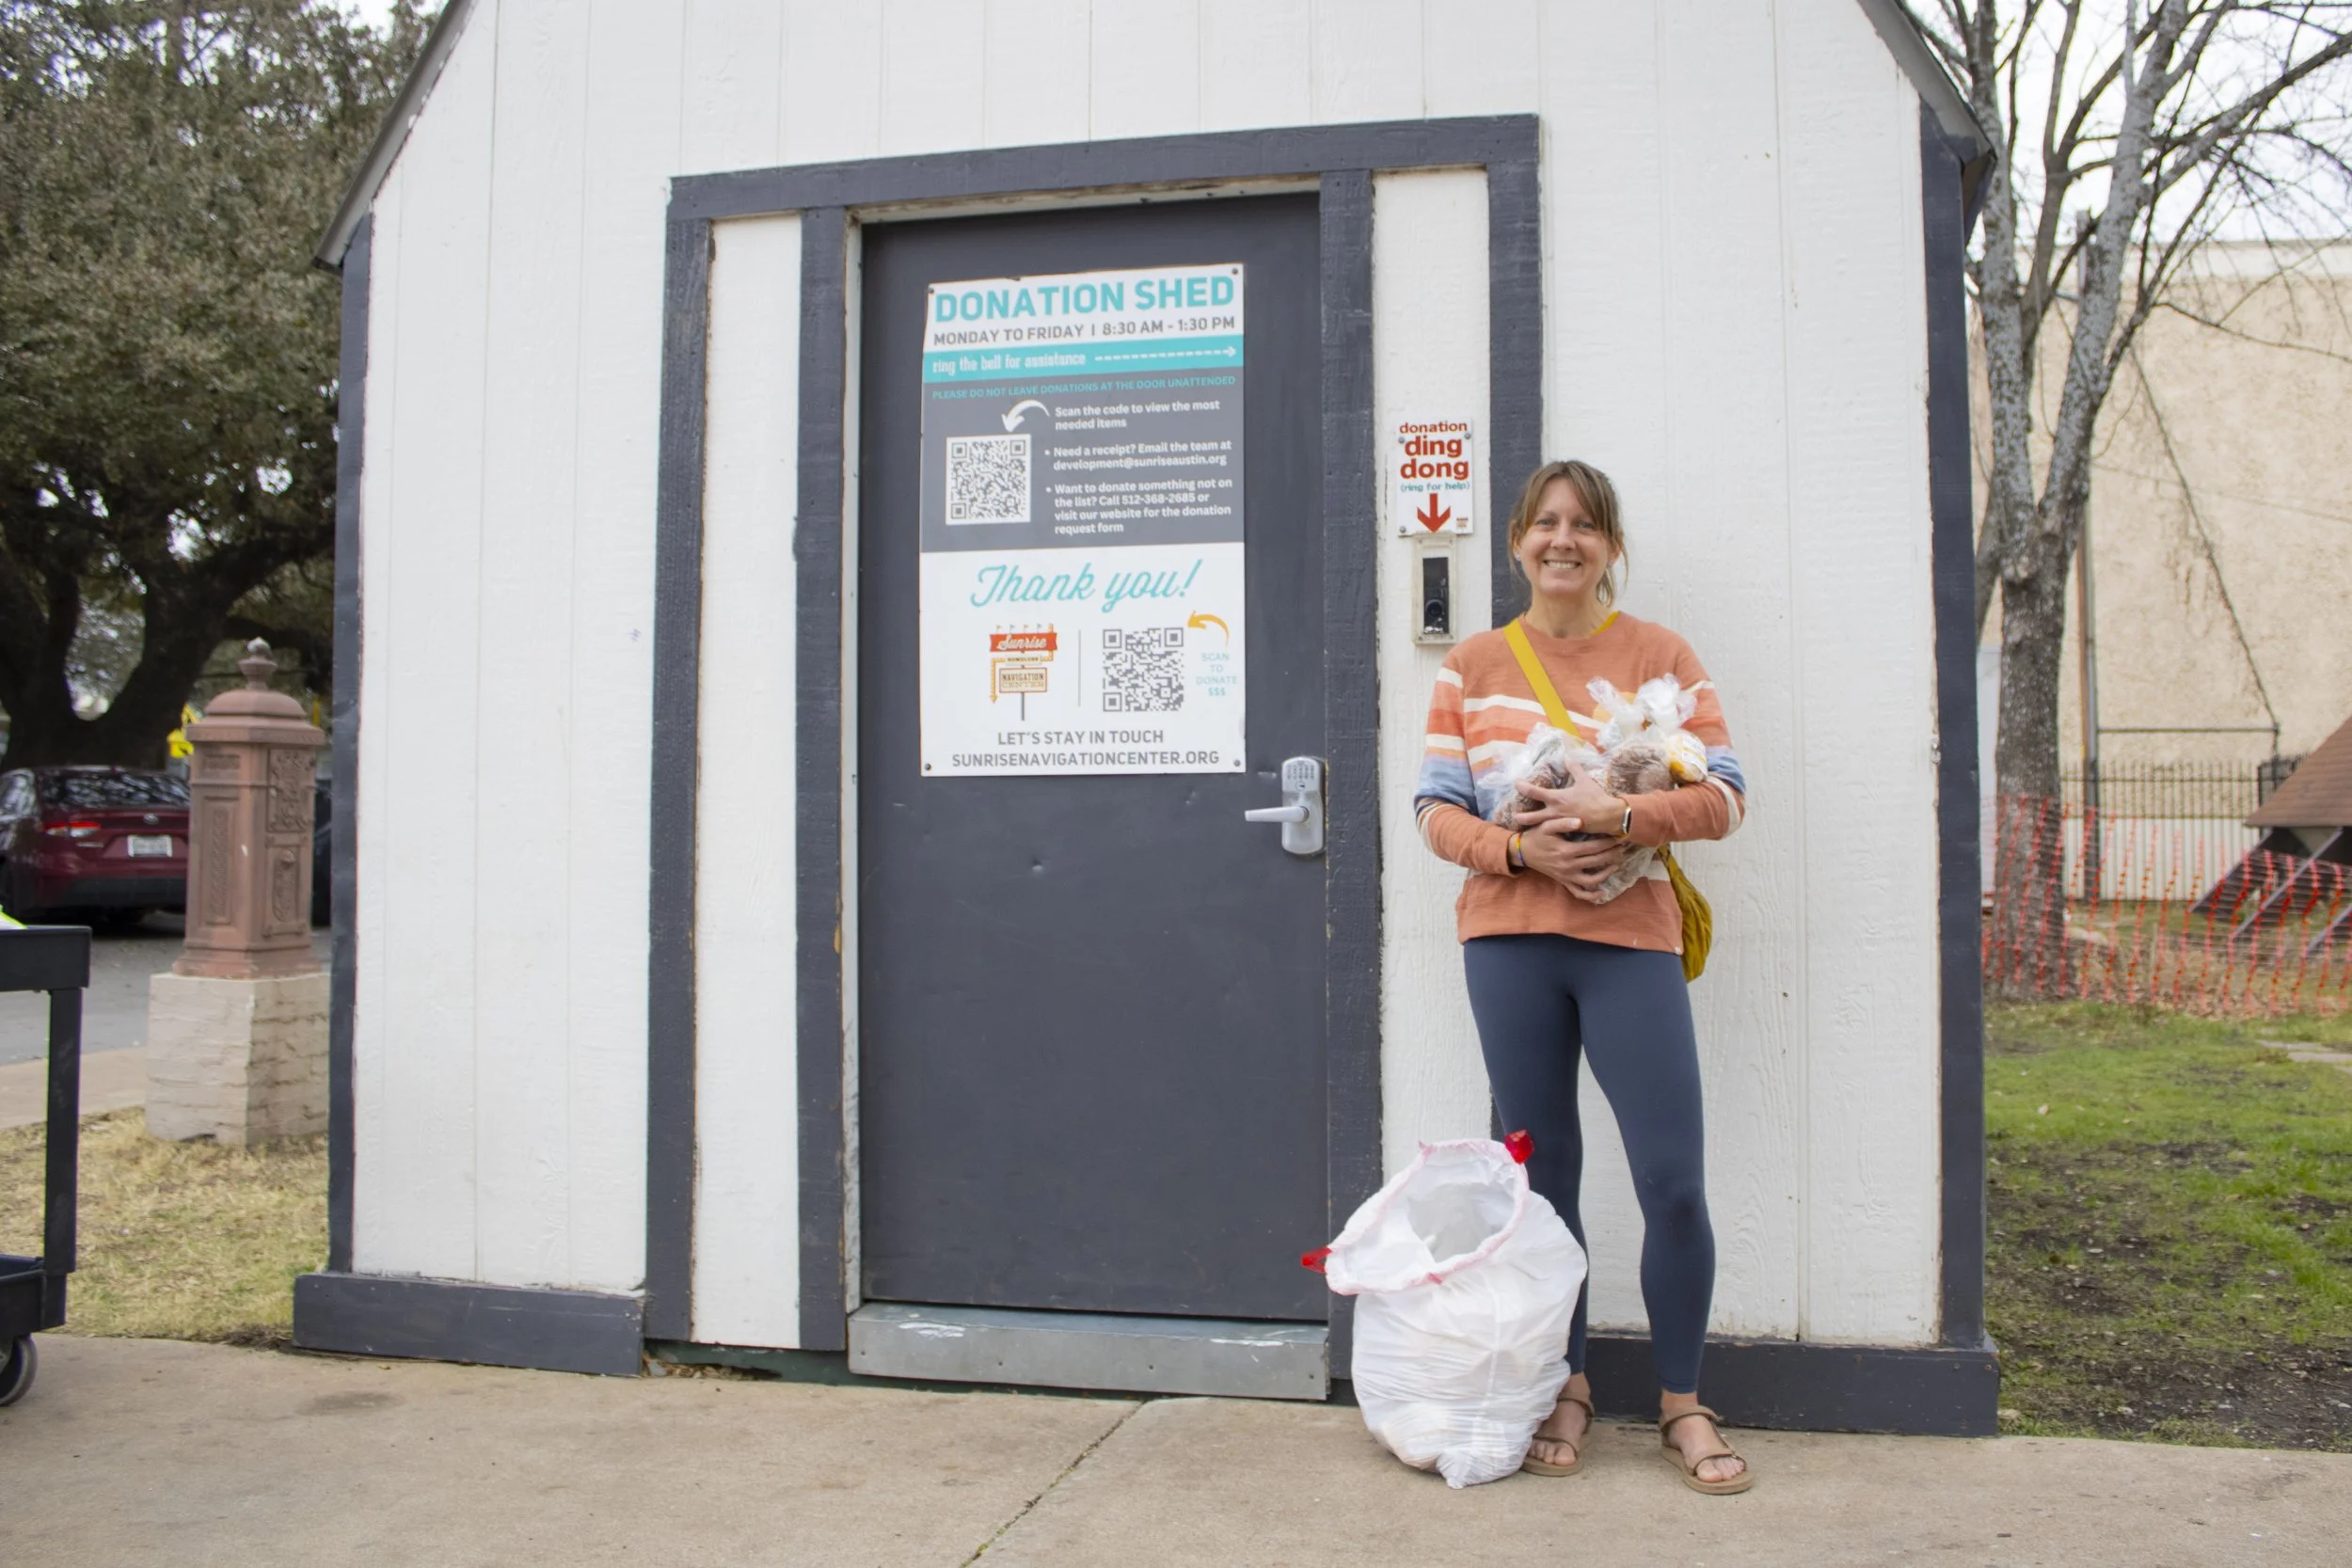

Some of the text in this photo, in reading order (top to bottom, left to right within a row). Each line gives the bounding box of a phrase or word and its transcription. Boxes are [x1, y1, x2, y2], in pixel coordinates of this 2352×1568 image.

[935, 275, 1234, 324] DONATION SHED
[933, 330, 1000, 346] MONDAY
[1004, 328, 1024, 341] TO
[1026, 324, 1085, 341] FRIDAY
[1102, 321, 1136, 336] 8:30
[1139, 319, 1164, 334] AM
[1178, 317, 1208, 332] 1:30
[1211, 315, 1235, 329] PM
[932, 351, 1087, 376] ring the bell for assistance
[932, 375, 1236, 400] PLEASE DO NOT LEAVE DONATIONS AT THE DOOR UNATTENDED
[1055, 400, 1220, 418] Scan the code to view the most
[1055, 418, 1127, 431] needed items
[1399, 420, 1468, 435] donation
[1054, 440, 1232, 457] Need a receipt? Email the team at
[1405, 435, 1462, 458] ding
[1054, 453, 1227, 471] development@sunriseaustin.org
[1400, 458, 1470, 481] dong
[1055, 478, 1232, 494] Want to donate something not on
[1400, 481, 1470, 493] (ring for help)
[1055, 492, 1210, 508] the list? Call 512-368-2685 or
[1055, 504, 1232, 521] visit our website for the donation
[1055, 521, 1124, 537] request form
[970, 559, 1204, 613] Thank you!
[996, 634, 1048, 651] Sunrise
[1200, 652, 1231, 662] SCAN
[1001, 673, 1044, 681] NAVIGATION
[1209, 664, 1224, 673] TO
[1195, 674, 1238, 686] DONATE
[1207, 687, 1227, 697] $$$
[997, 729, 1165, 746] LET'S STAY IN TOUCH
[952, 751, 1220, 768] SUNRISENAVIGATIONCENTER.ORG
